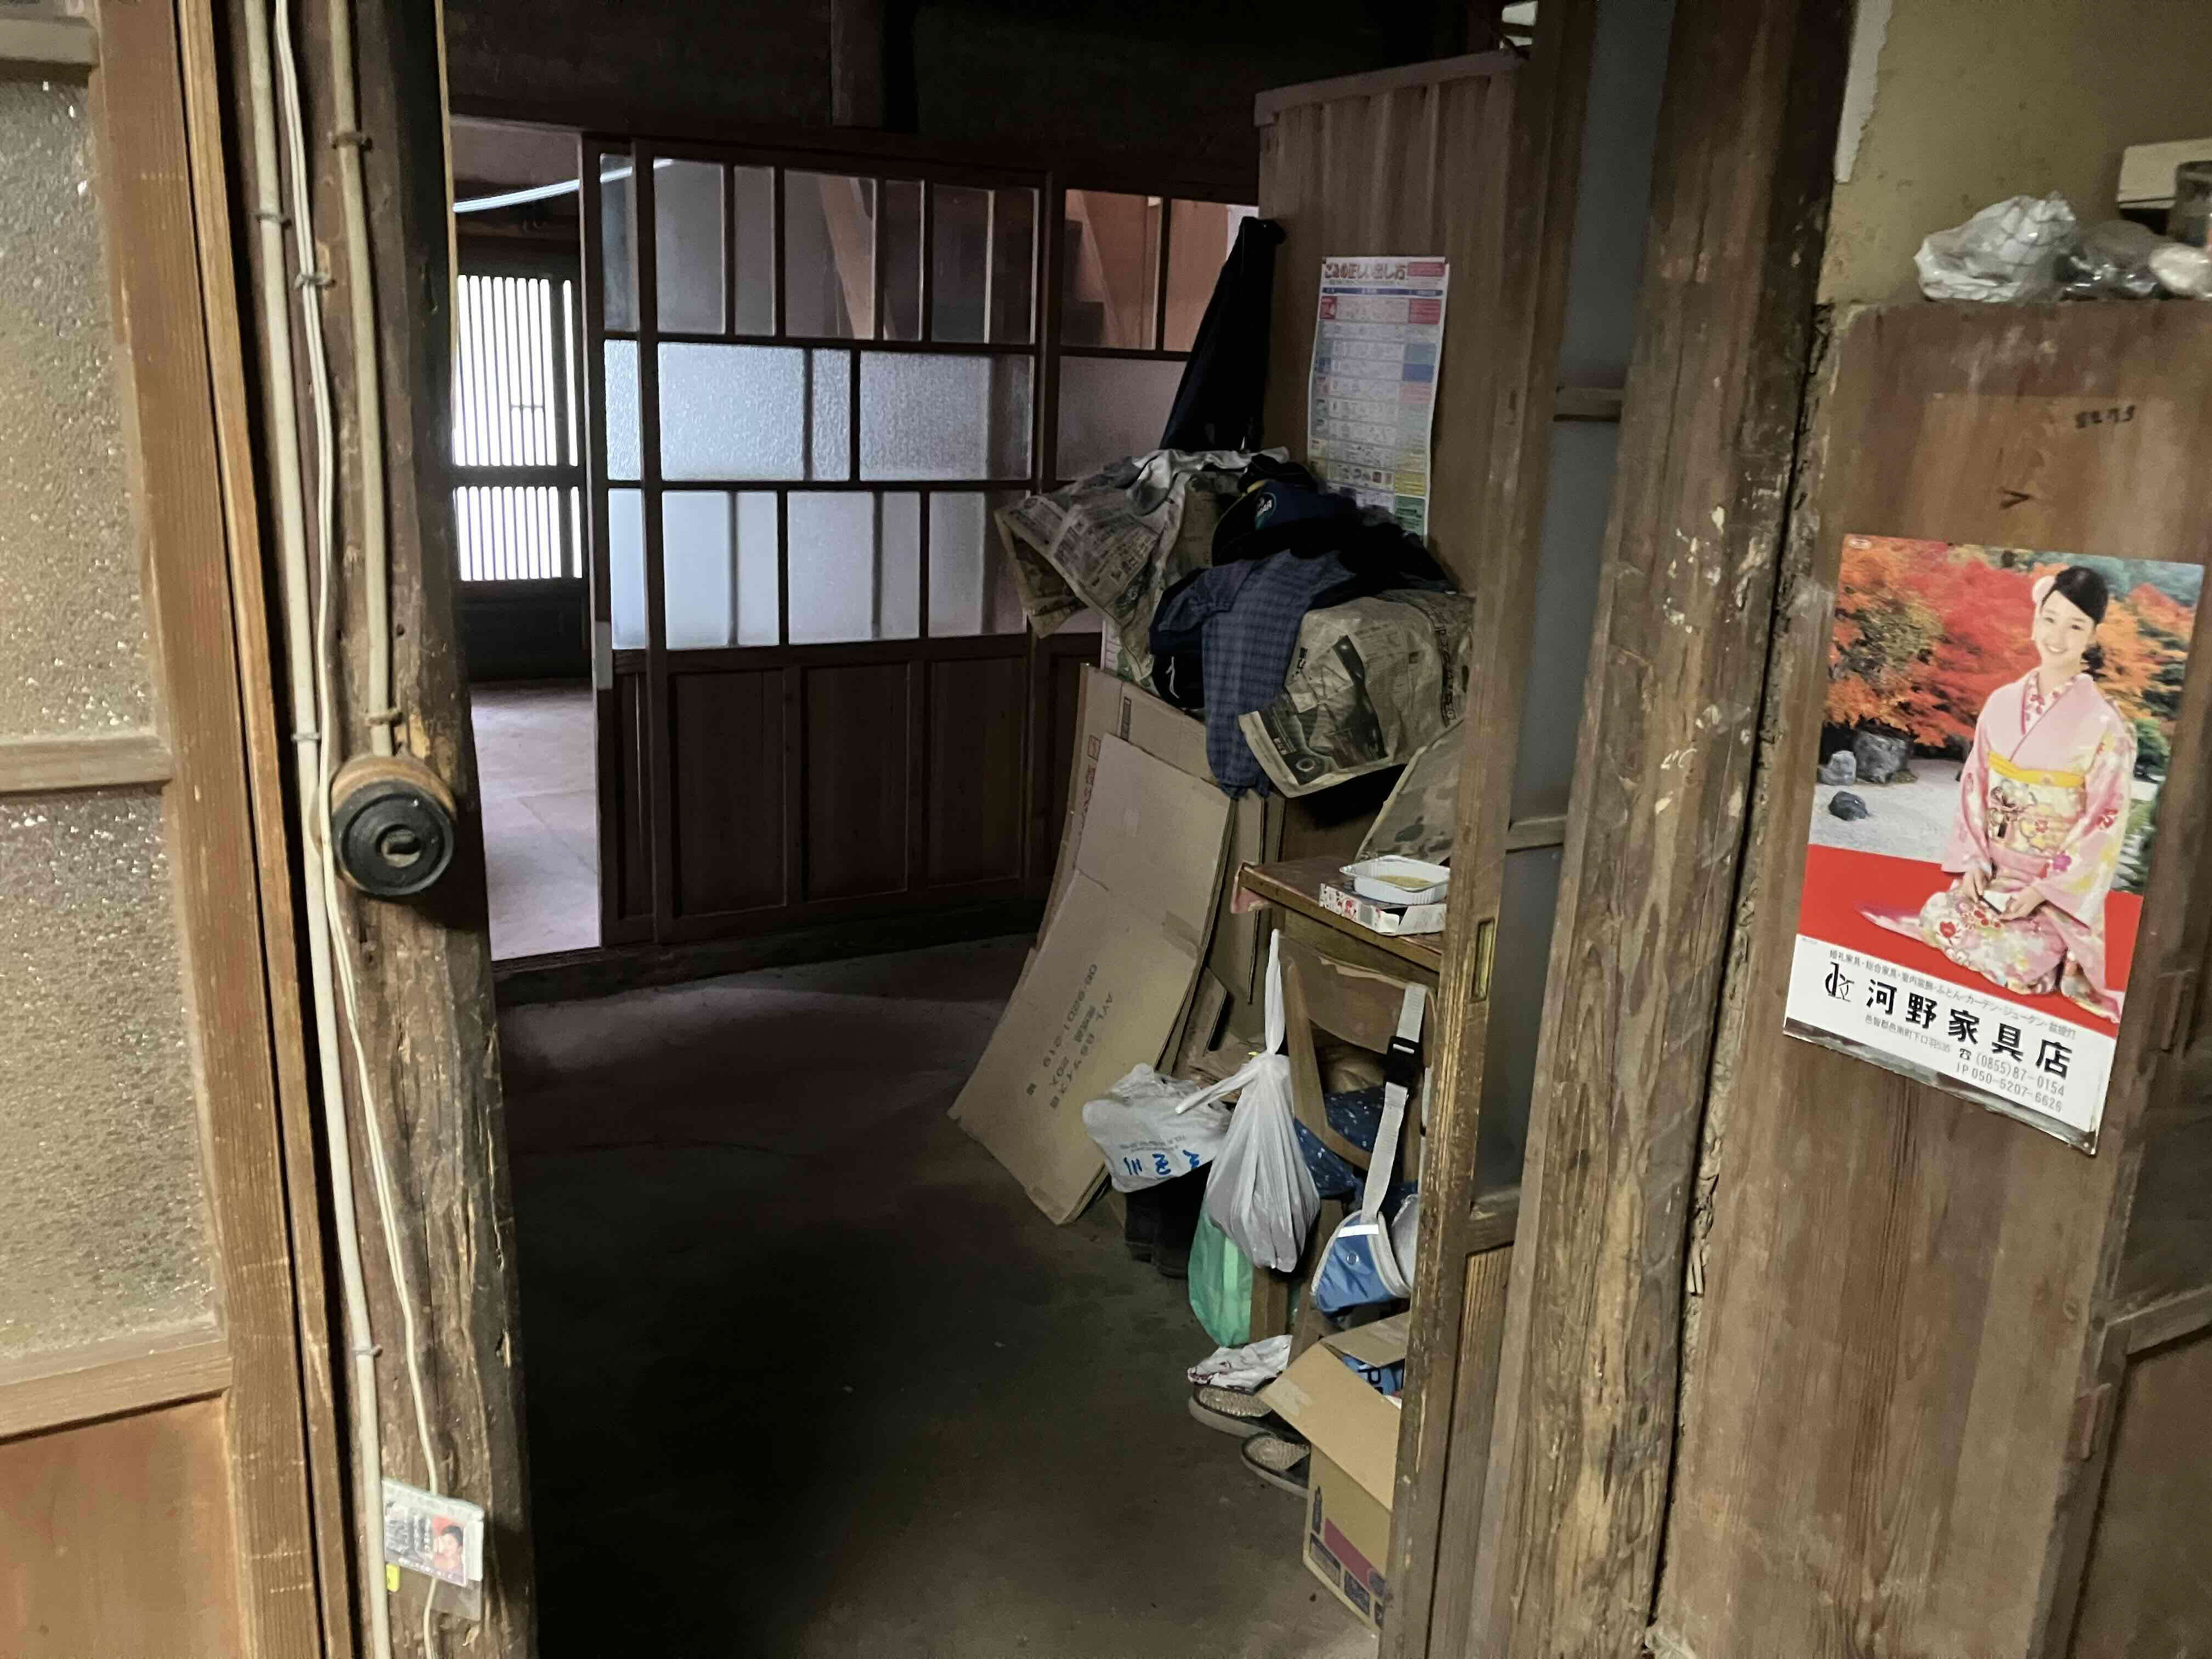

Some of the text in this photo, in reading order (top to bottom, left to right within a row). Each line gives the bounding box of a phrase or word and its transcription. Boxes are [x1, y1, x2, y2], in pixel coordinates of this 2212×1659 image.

[1866, 979, 2073, 1080] 河野家具店
